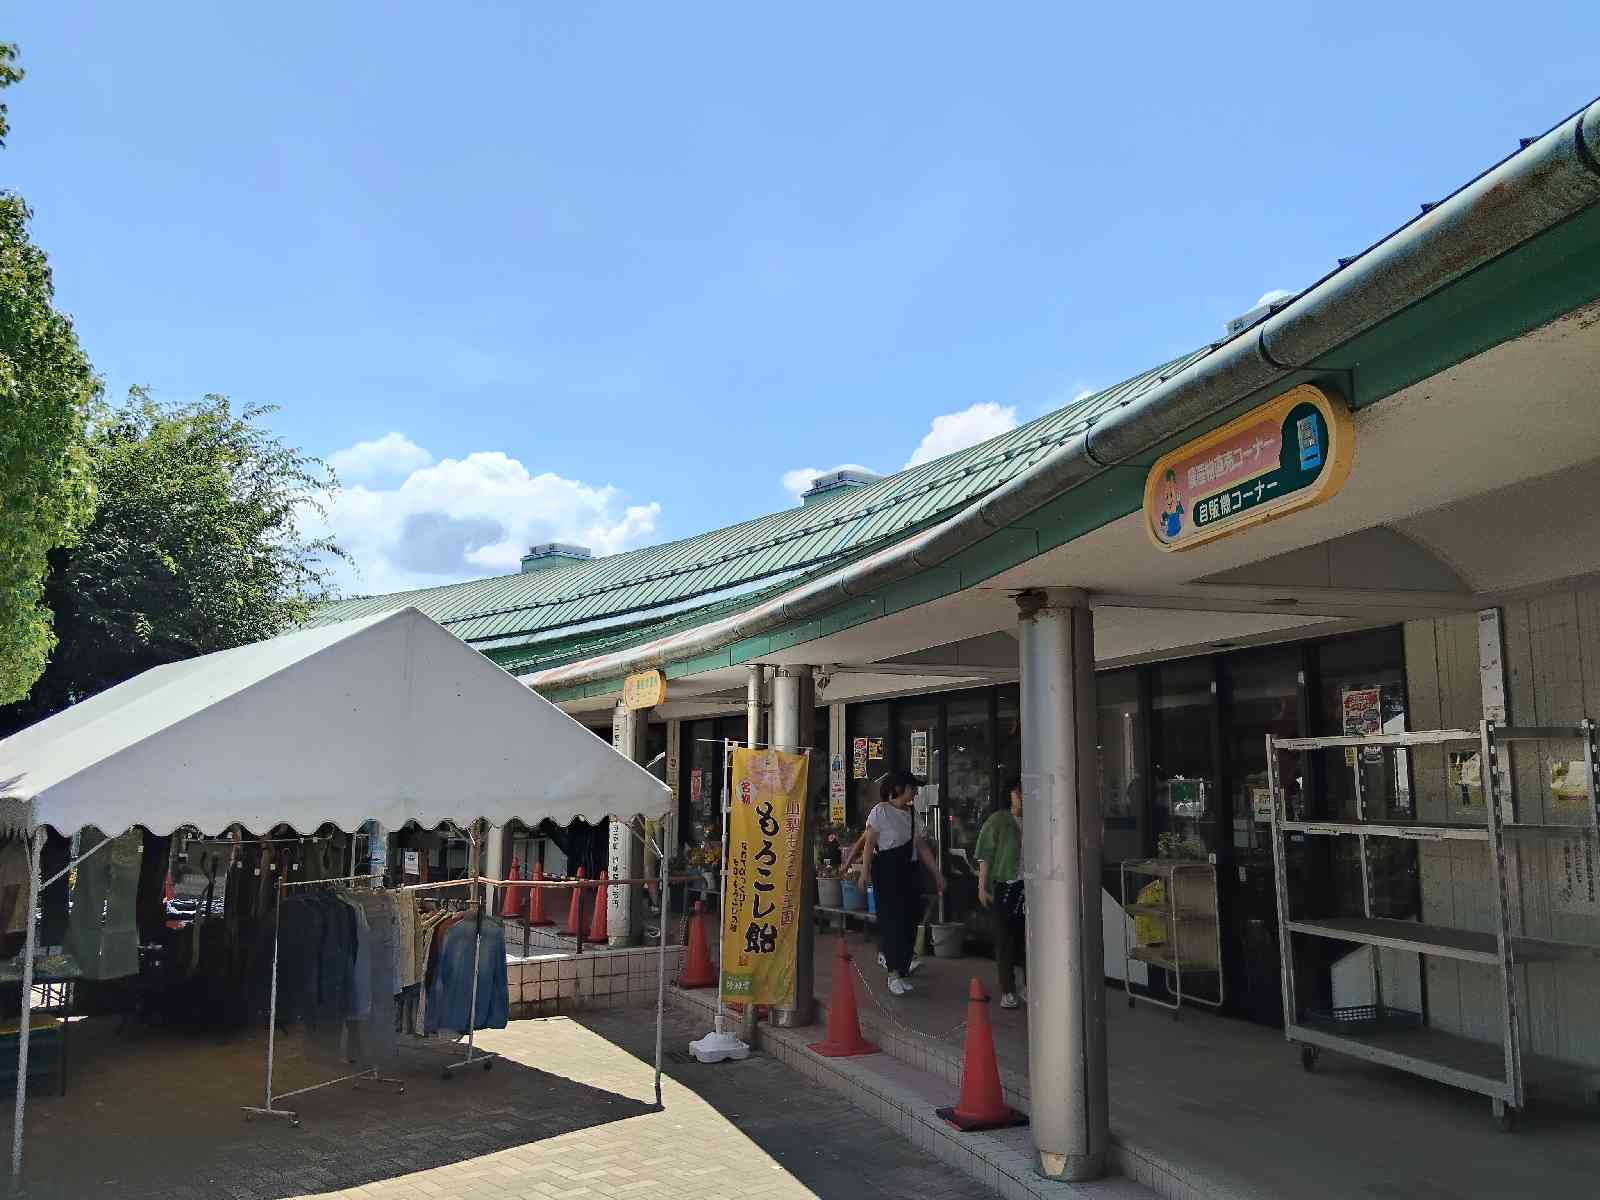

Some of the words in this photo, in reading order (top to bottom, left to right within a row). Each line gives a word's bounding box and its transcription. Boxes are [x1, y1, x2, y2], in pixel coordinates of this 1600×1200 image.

[1199, 480, 1279, 523] 自販機コーナー
[744, 801, 779, 953] もろこし飴
